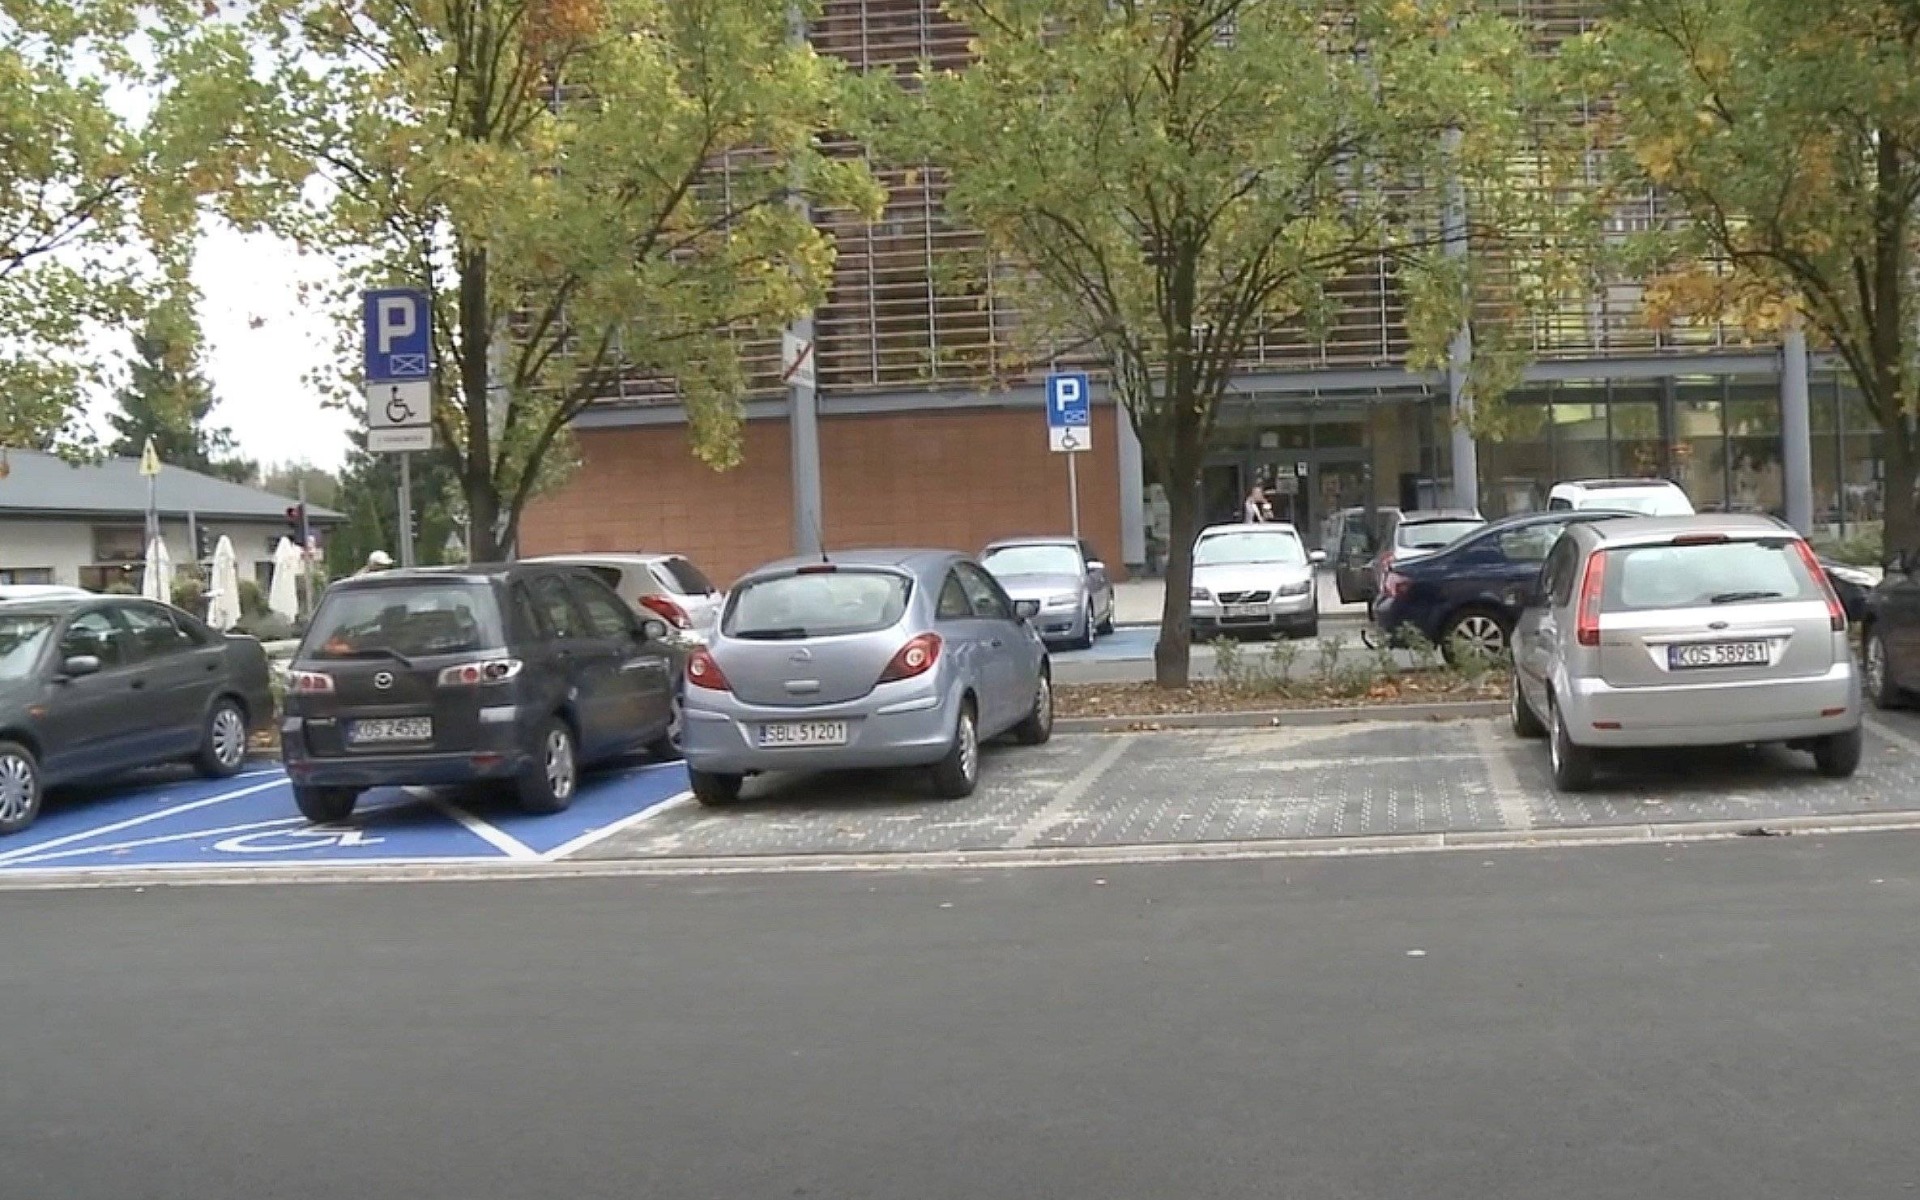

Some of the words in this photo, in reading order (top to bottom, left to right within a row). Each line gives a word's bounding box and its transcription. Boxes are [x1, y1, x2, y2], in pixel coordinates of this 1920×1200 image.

[378, 296, 416, 354] P
[1056, 378, 1080, 411] P
[1678, 646, 1711, 665] KOS
[1715, 643, 1764, 663] 58981
[768, 725, 794, 741] SBL
[800, 723, 843, 740] 51201
